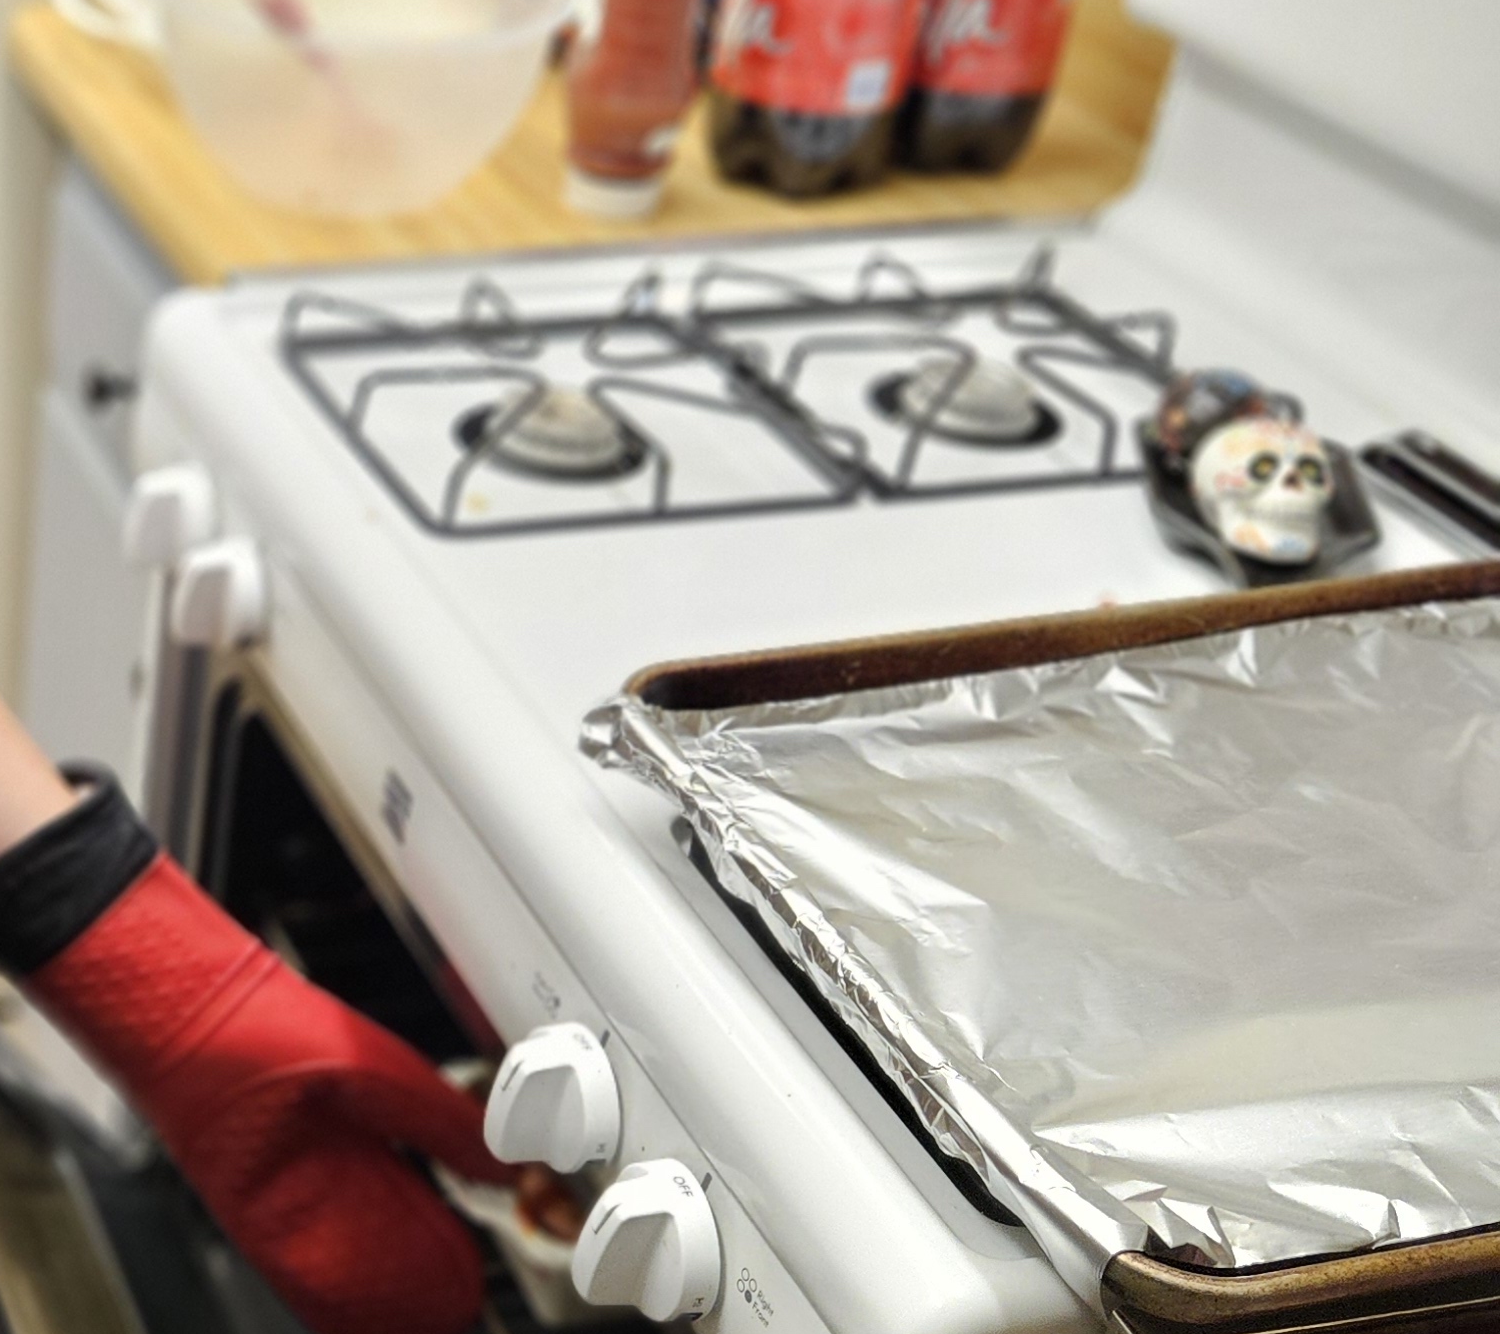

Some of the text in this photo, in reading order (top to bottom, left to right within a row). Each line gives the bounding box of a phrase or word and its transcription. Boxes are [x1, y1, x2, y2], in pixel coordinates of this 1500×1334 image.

[672, 1175, 694, 1199] OFF
[751, 1301, 770, 1328] Front
[757, 1289, 775, 1317] Right
